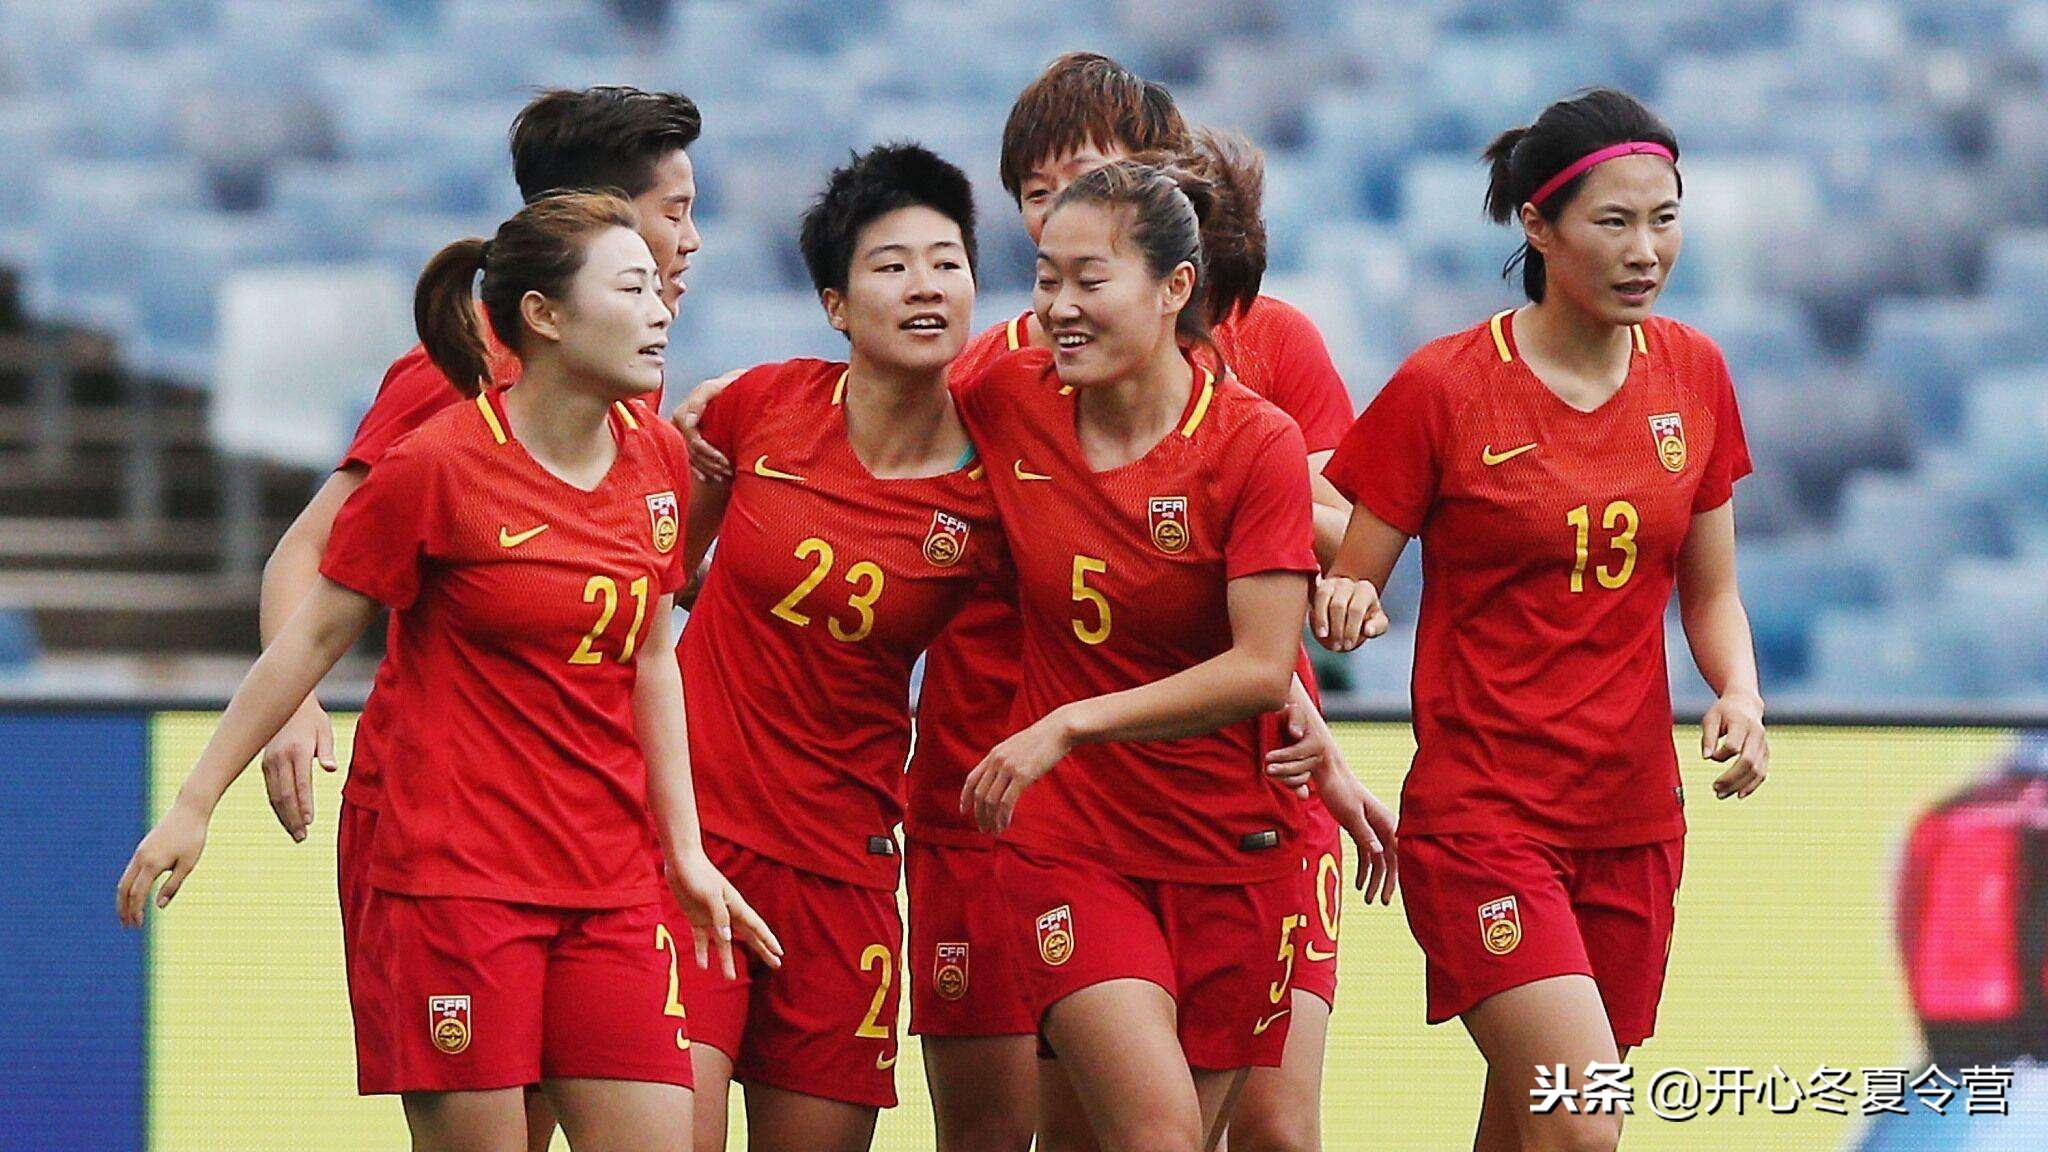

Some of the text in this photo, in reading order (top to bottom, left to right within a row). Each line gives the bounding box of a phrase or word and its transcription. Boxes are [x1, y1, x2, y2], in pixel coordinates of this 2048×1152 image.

[937, 512, 967, 533] CFA
[1152, 500, 1183, 512] CFA
[1567, 500, 1640, 592] 13
[567, 575, 648, 664] 21
[770, 537, 885, 642] 23
[1072, 554, 1111, 645] 5
[938, 946, 966, 958] CFA
[1039, 910, 1068, 930] CFA
[1481, 900, 1514, 919] CFA
[655, 923, 687, 1018] 2
[854, 943, 901, 1038] 2
[1269, 913, 1300, 1004] 5
[433, 999, 467, 1012] CFA
